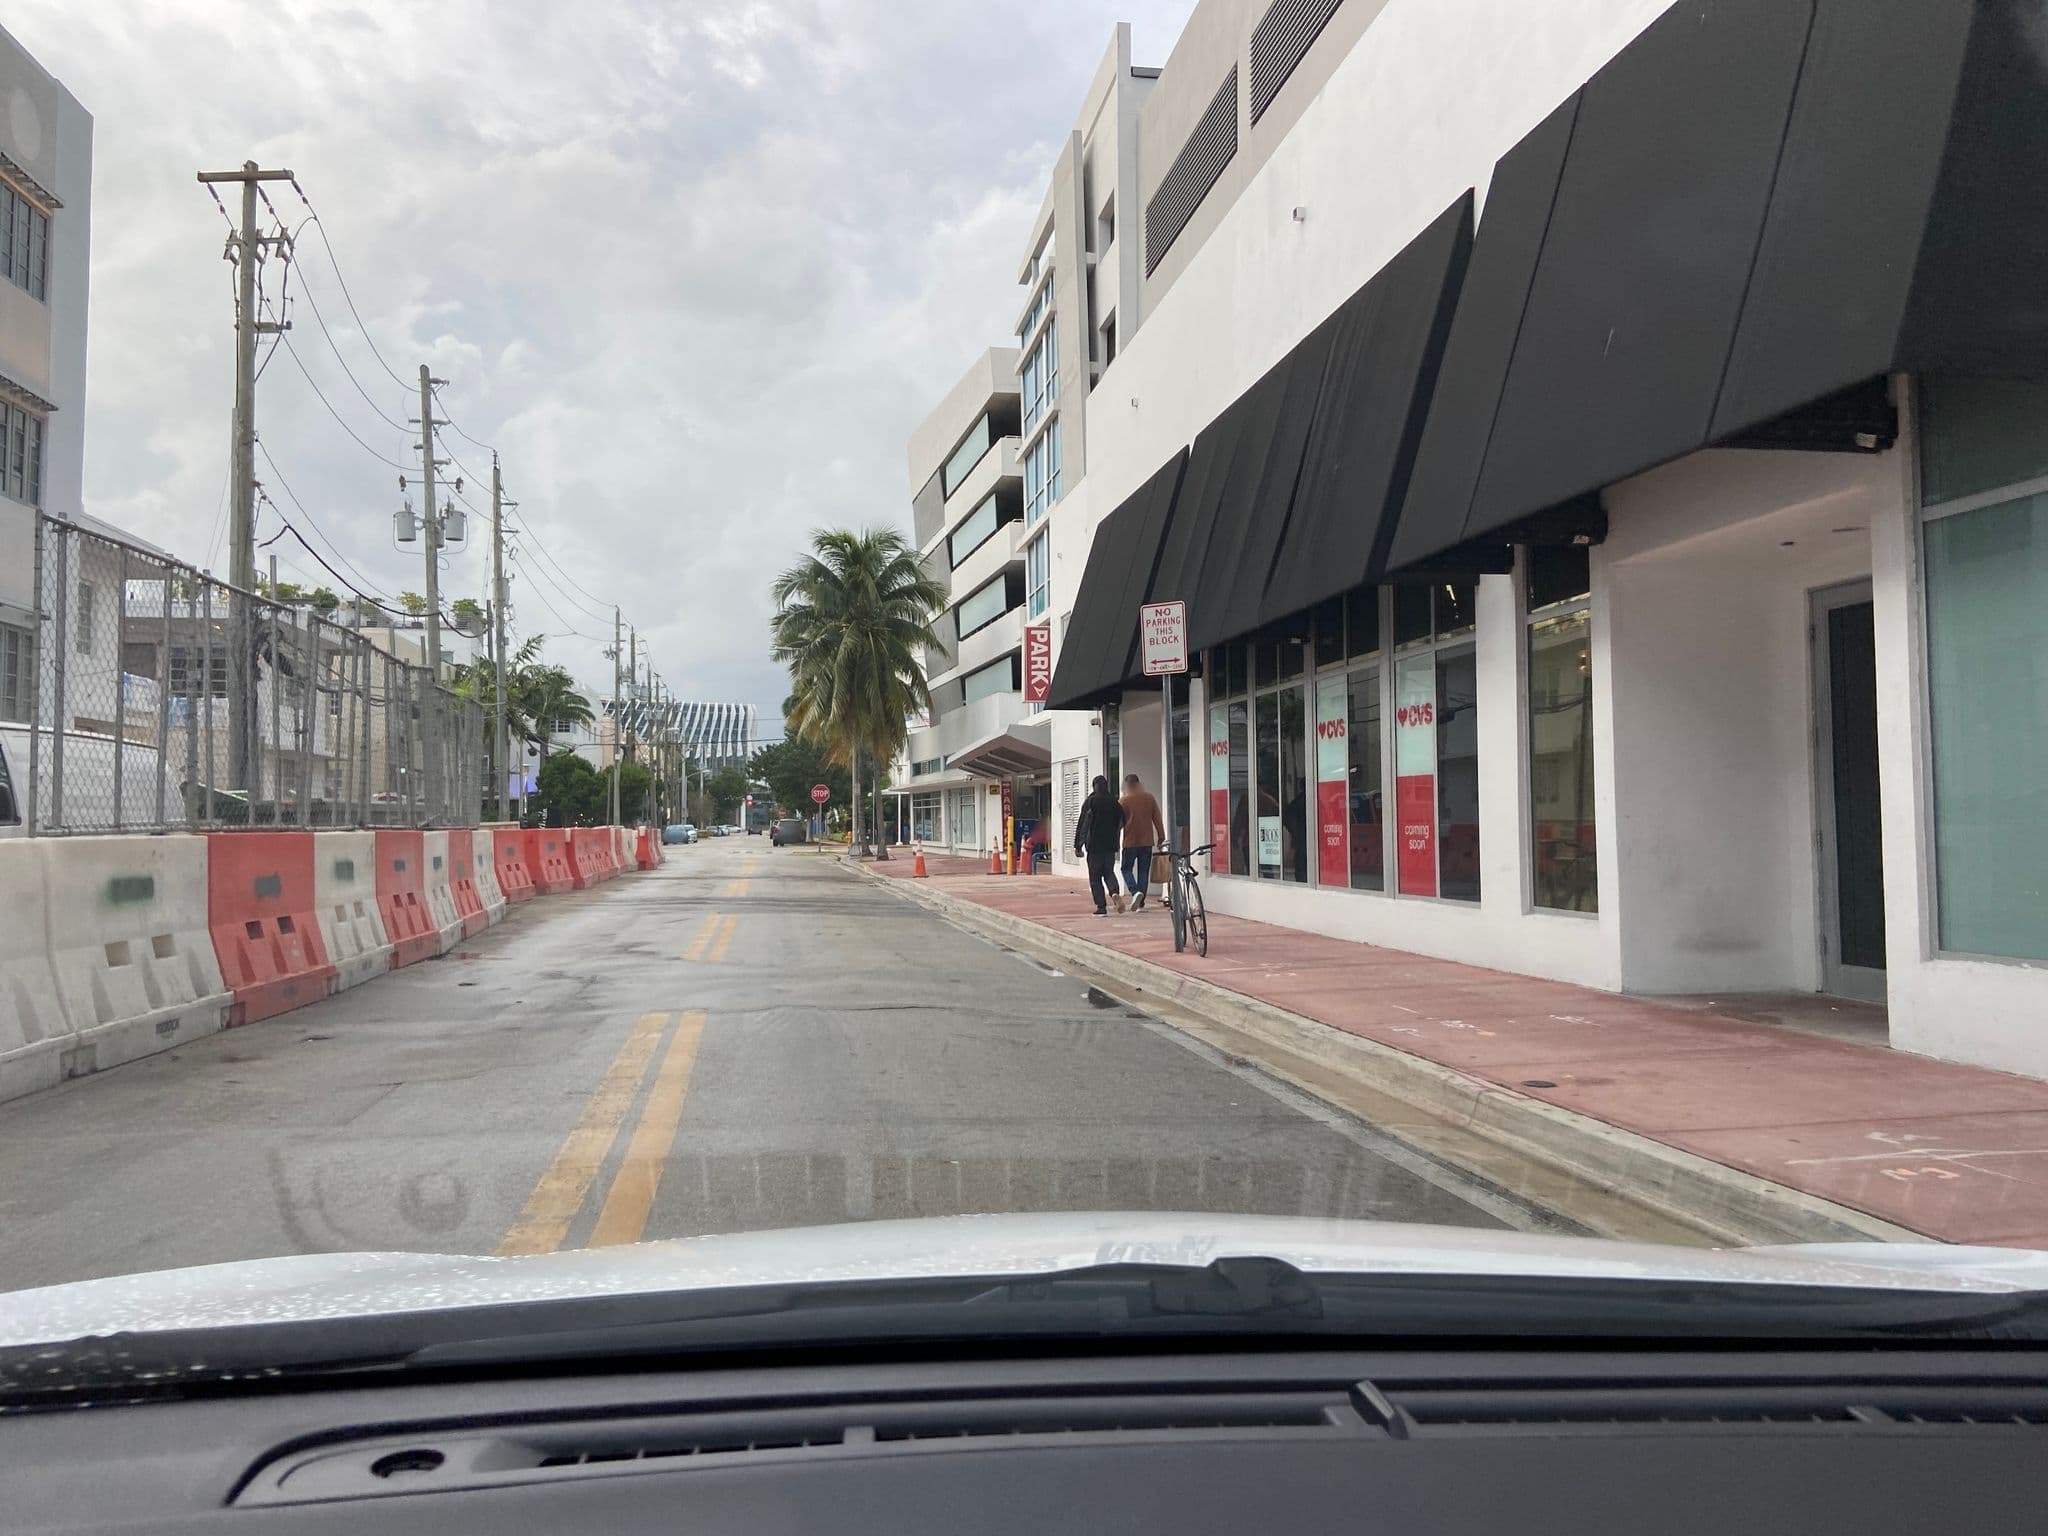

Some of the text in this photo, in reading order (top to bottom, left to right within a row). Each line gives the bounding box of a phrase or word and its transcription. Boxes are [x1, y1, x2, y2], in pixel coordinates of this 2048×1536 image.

[1155, 607, 1171, 617] NO
[1146, 616, 1181, 628] PARKING
[1156, 626, 1174, 636] THIS
[1150, 635, 1180, 646] BLOCK
[1030, 629, 1049, 685] PARK
[1409, 702, 1433, 727] CVS
[1327, 718, 1345, 739] CVS
[1216, 740, 1228, 756] CVS
[813, 790, 829, 798] STOP
[1323, 824, 1343, 836] coming
[1404, 825, 1430, 839] coming
[1327, 836, 1340, 846] soon
[1409, 839, 1426, 850] soon
